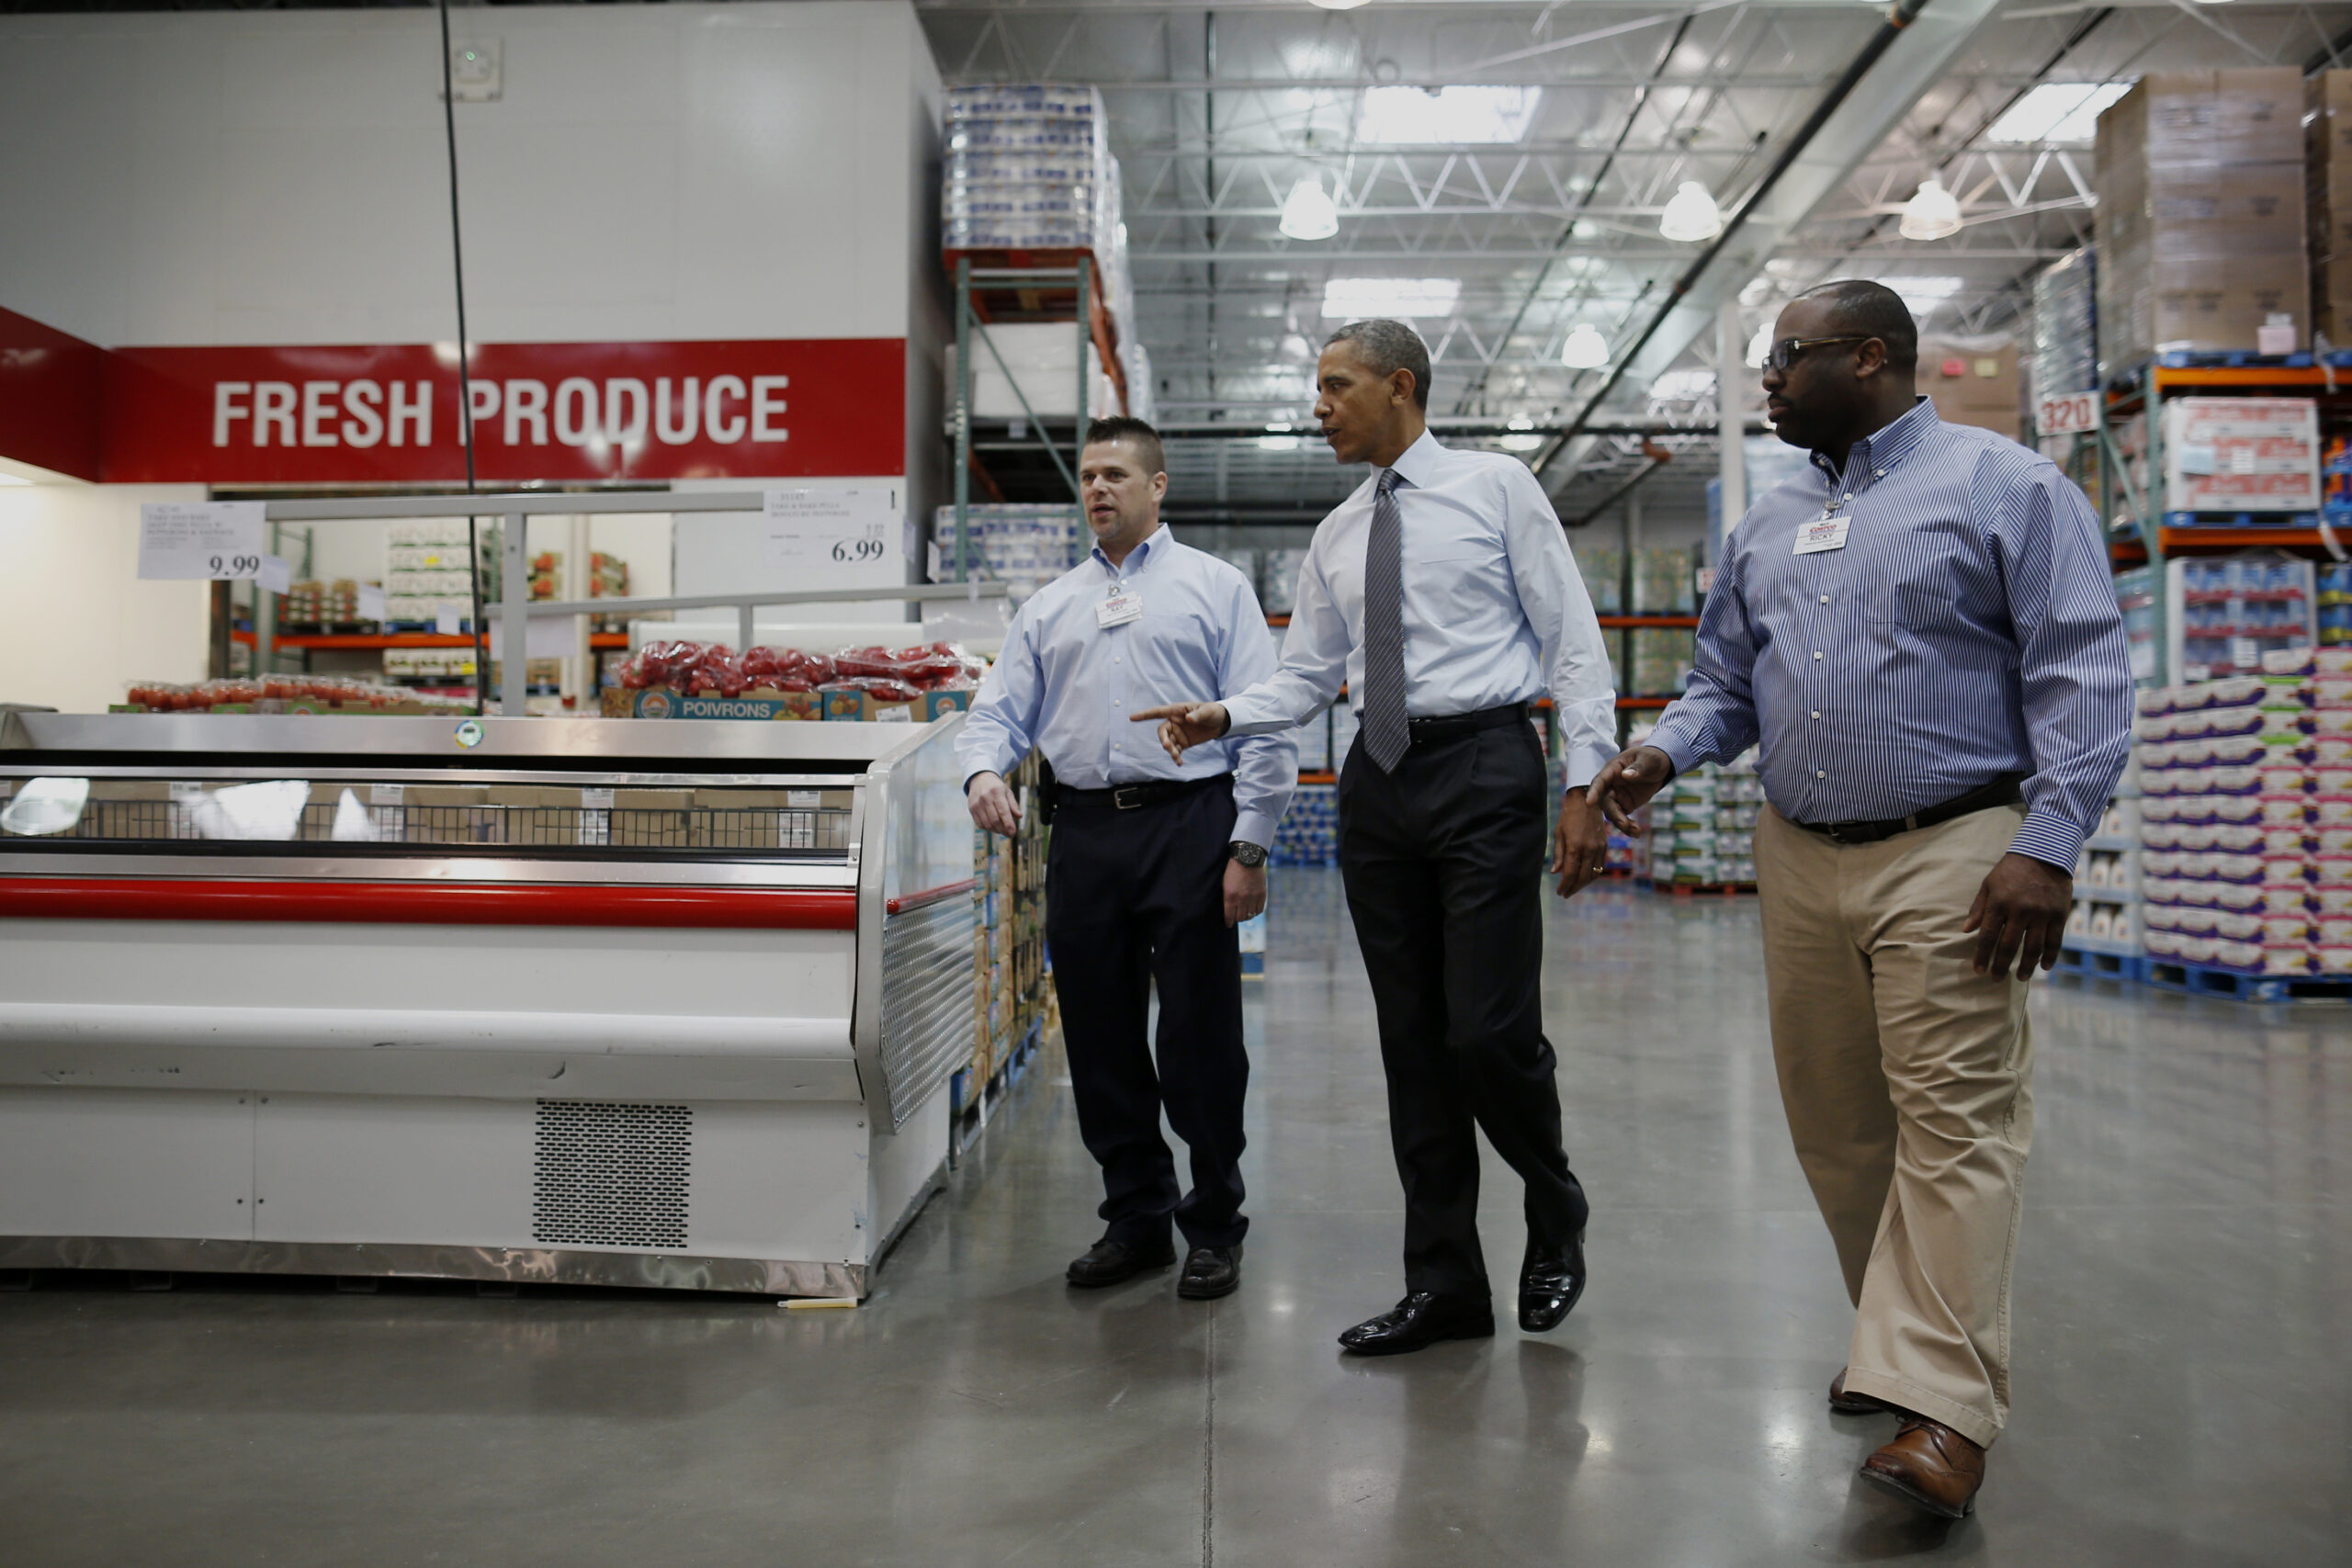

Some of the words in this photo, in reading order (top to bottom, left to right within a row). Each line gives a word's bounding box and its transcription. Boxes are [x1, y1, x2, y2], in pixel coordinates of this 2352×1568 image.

[212, 379, 433, 447] FRESH
[459, 375, 789, 446] PRODUCE
[2041, 397, 2091, 431] 320
[831, 538, 885, 562] 6.99
[209, 555, 260, 576] 9.99
[683, 702, 771, 718] POIVRONS
